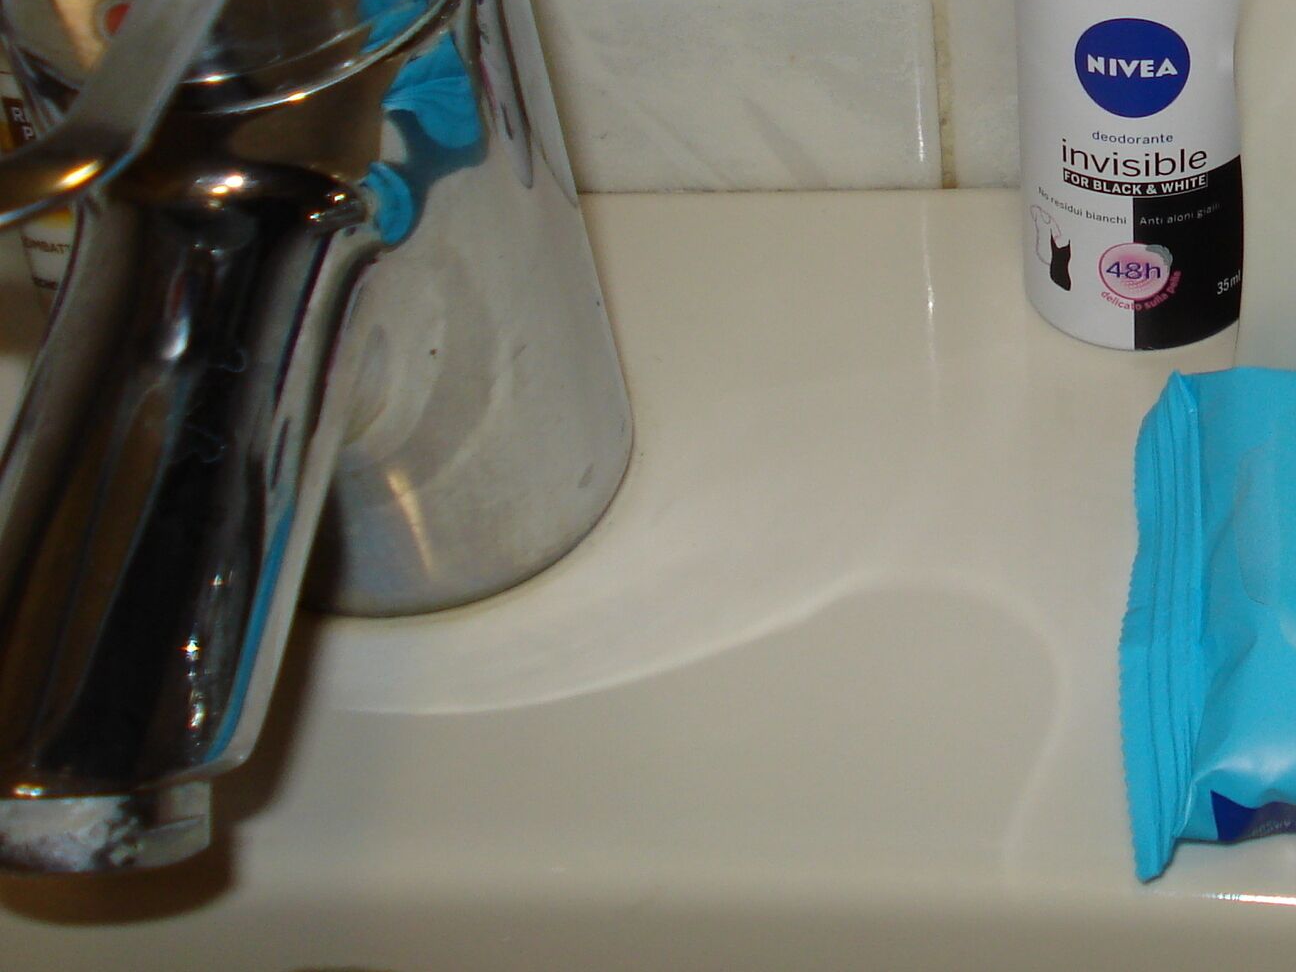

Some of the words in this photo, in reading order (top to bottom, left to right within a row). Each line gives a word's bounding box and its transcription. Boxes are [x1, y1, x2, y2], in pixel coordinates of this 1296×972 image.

[1087, 53, 1178, 78] NIVEA
[1092, 130, 1173, 144] deodorante
[1061, 138, 1207, 177] invisible
[1064, 170, 1089, 188] FOR
[1093, 179, 1142, 195] BLACK
[1146, 184, 1157, 195] &
[1161, 174, 1206, 193] WHITE
[1050, 197, 1083, 216] residui
[1085, 210, 1127, 225] bianchi
[1106, 260, 1161, 279] 48h
